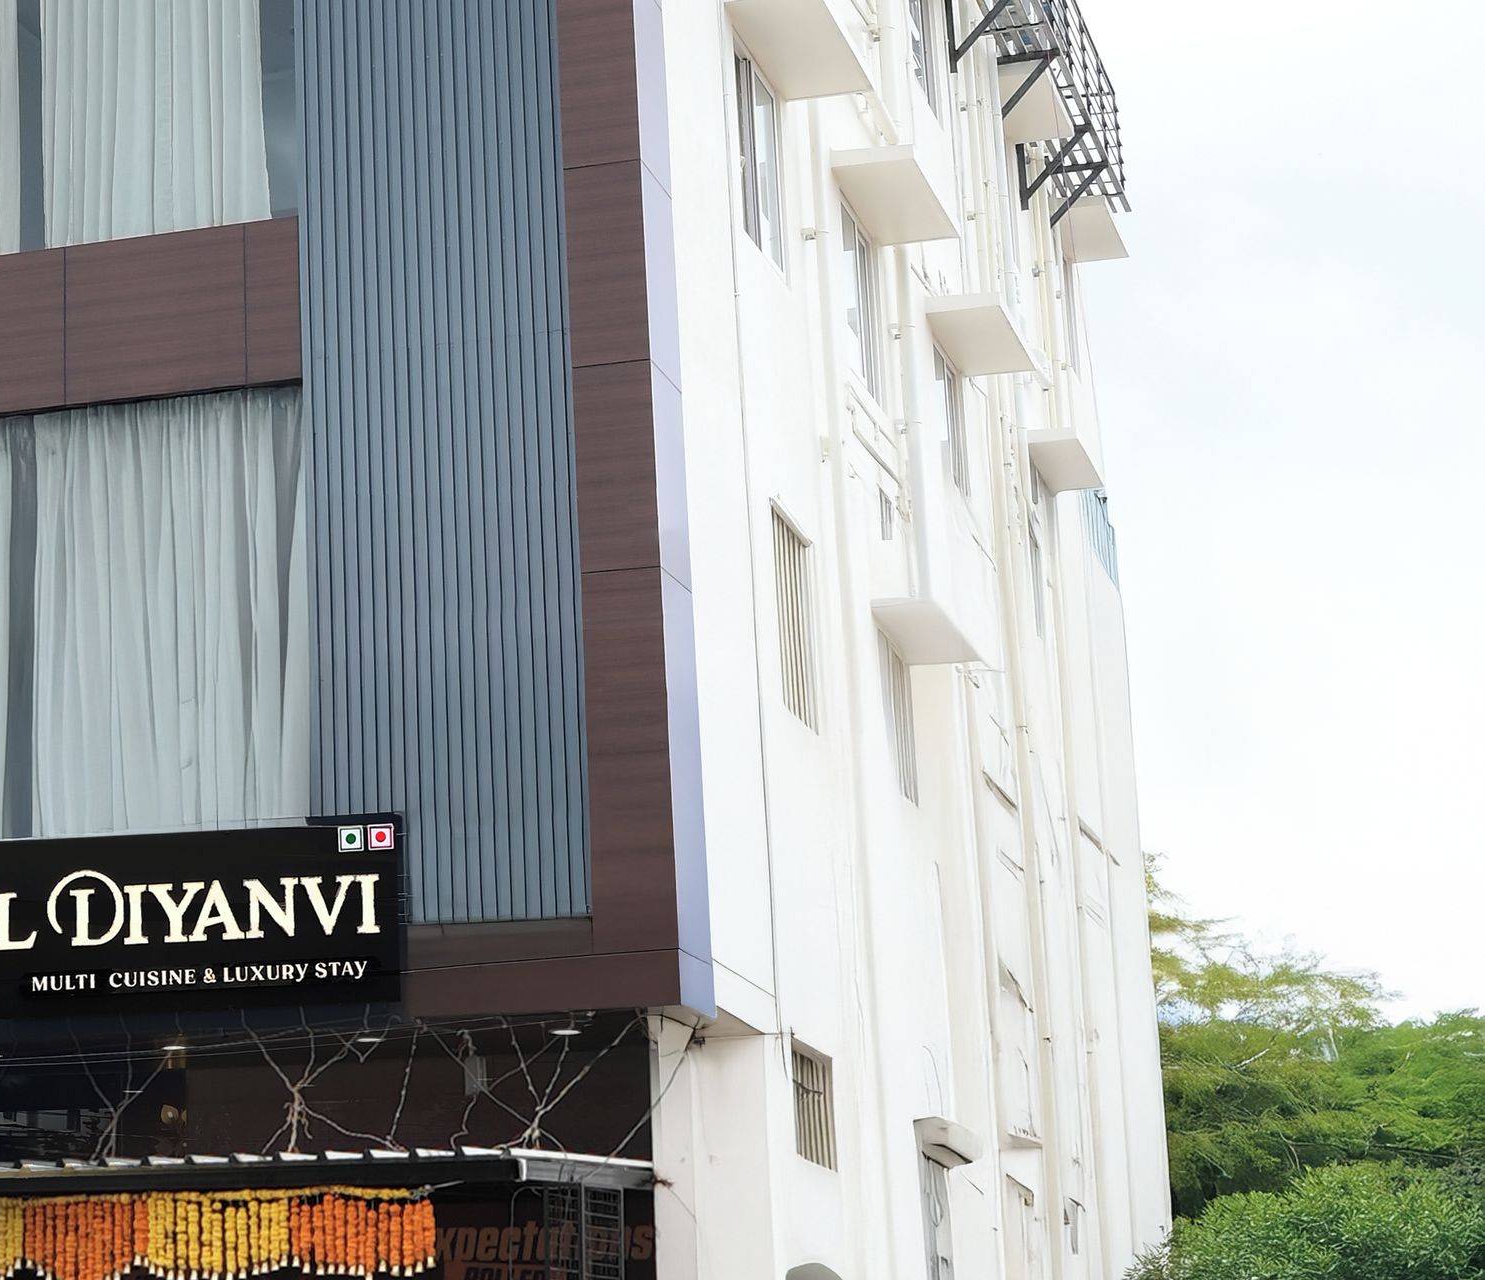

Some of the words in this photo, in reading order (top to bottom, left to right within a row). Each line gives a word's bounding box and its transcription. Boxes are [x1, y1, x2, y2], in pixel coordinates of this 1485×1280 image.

[47, 869, 381, 948] DIYANVI
[31, 973, 96, 992] MULTI
[109, 968, 196, 988] CUISINE
[203, 967, 217, 983] &
[223, 963, 308, 983] LUXURY
[315, 960, 368, 979] STAY
